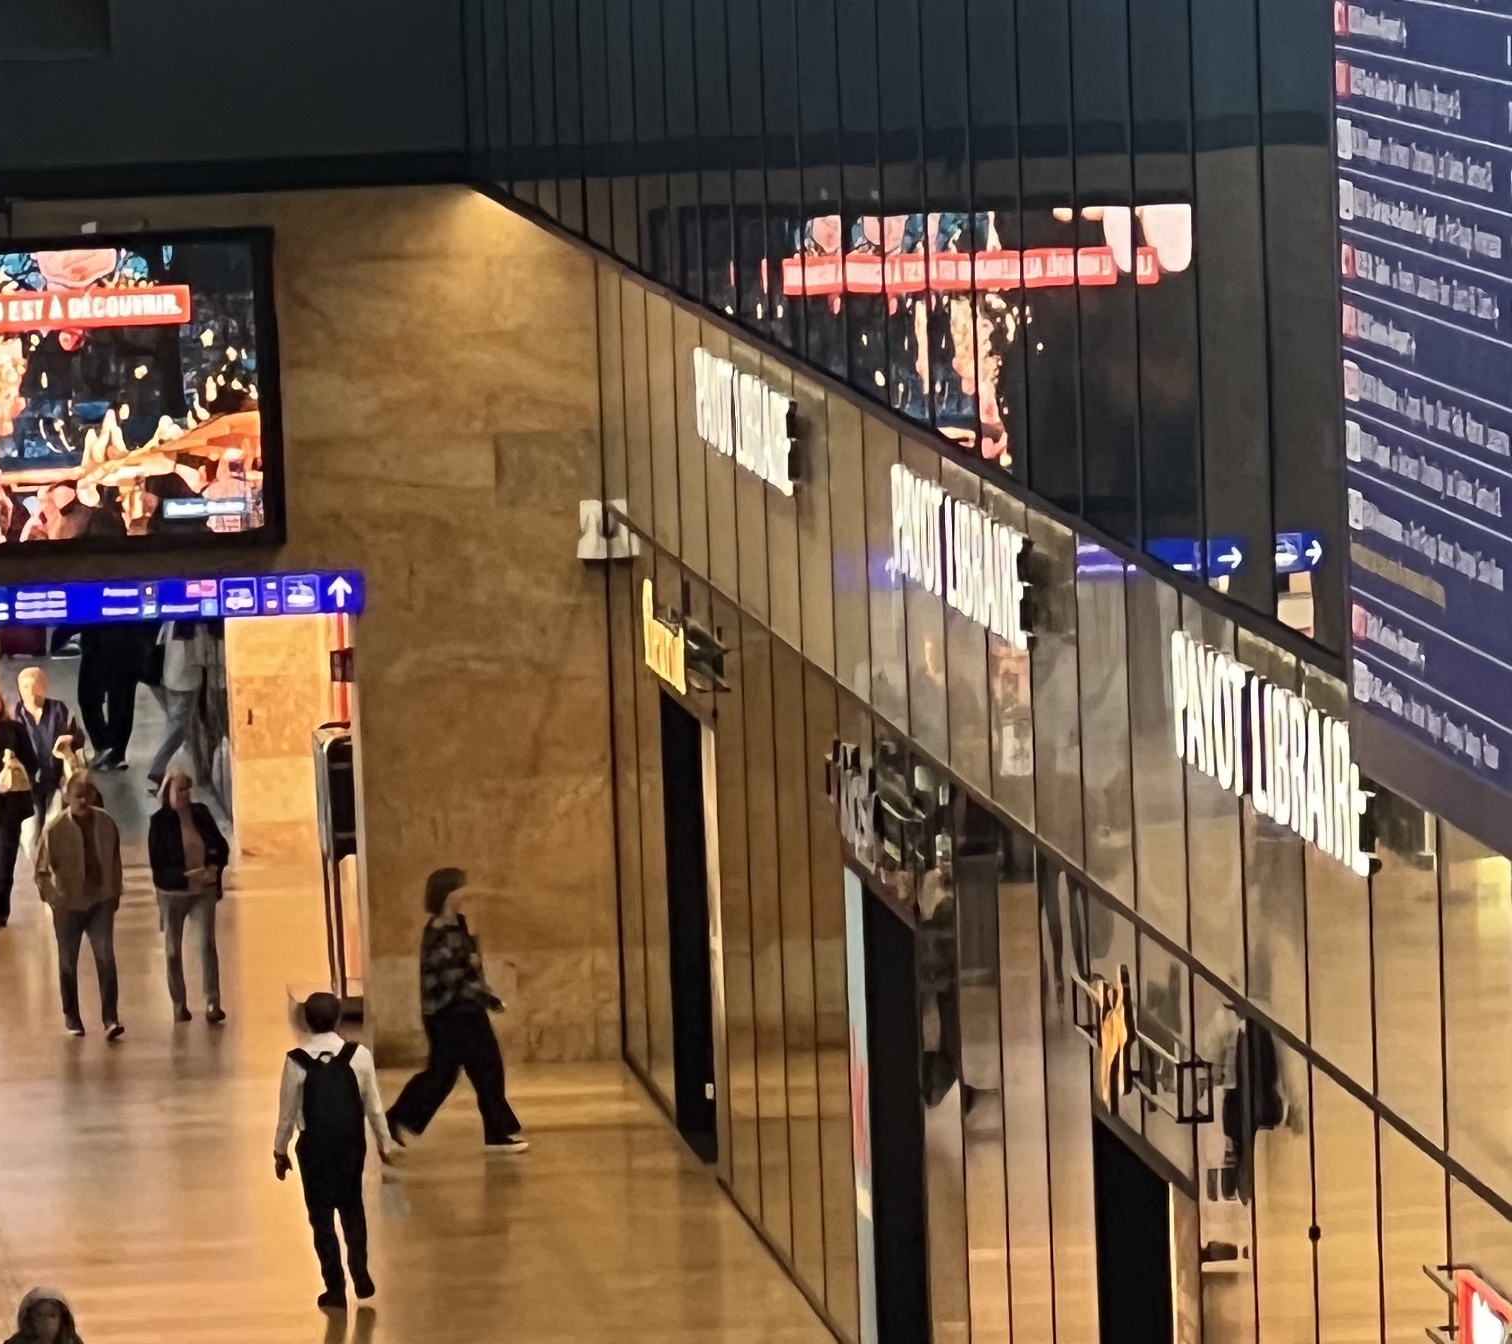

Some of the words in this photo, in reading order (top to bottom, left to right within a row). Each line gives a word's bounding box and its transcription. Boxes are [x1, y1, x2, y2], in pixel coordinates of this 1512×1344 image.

[7, 298, 44, 322] EST
[48, 294, 64, 320] À
[1171, 630, 1246, 796] PAYOT
[1250, 674, 1370, 877] LIBRAIRE
